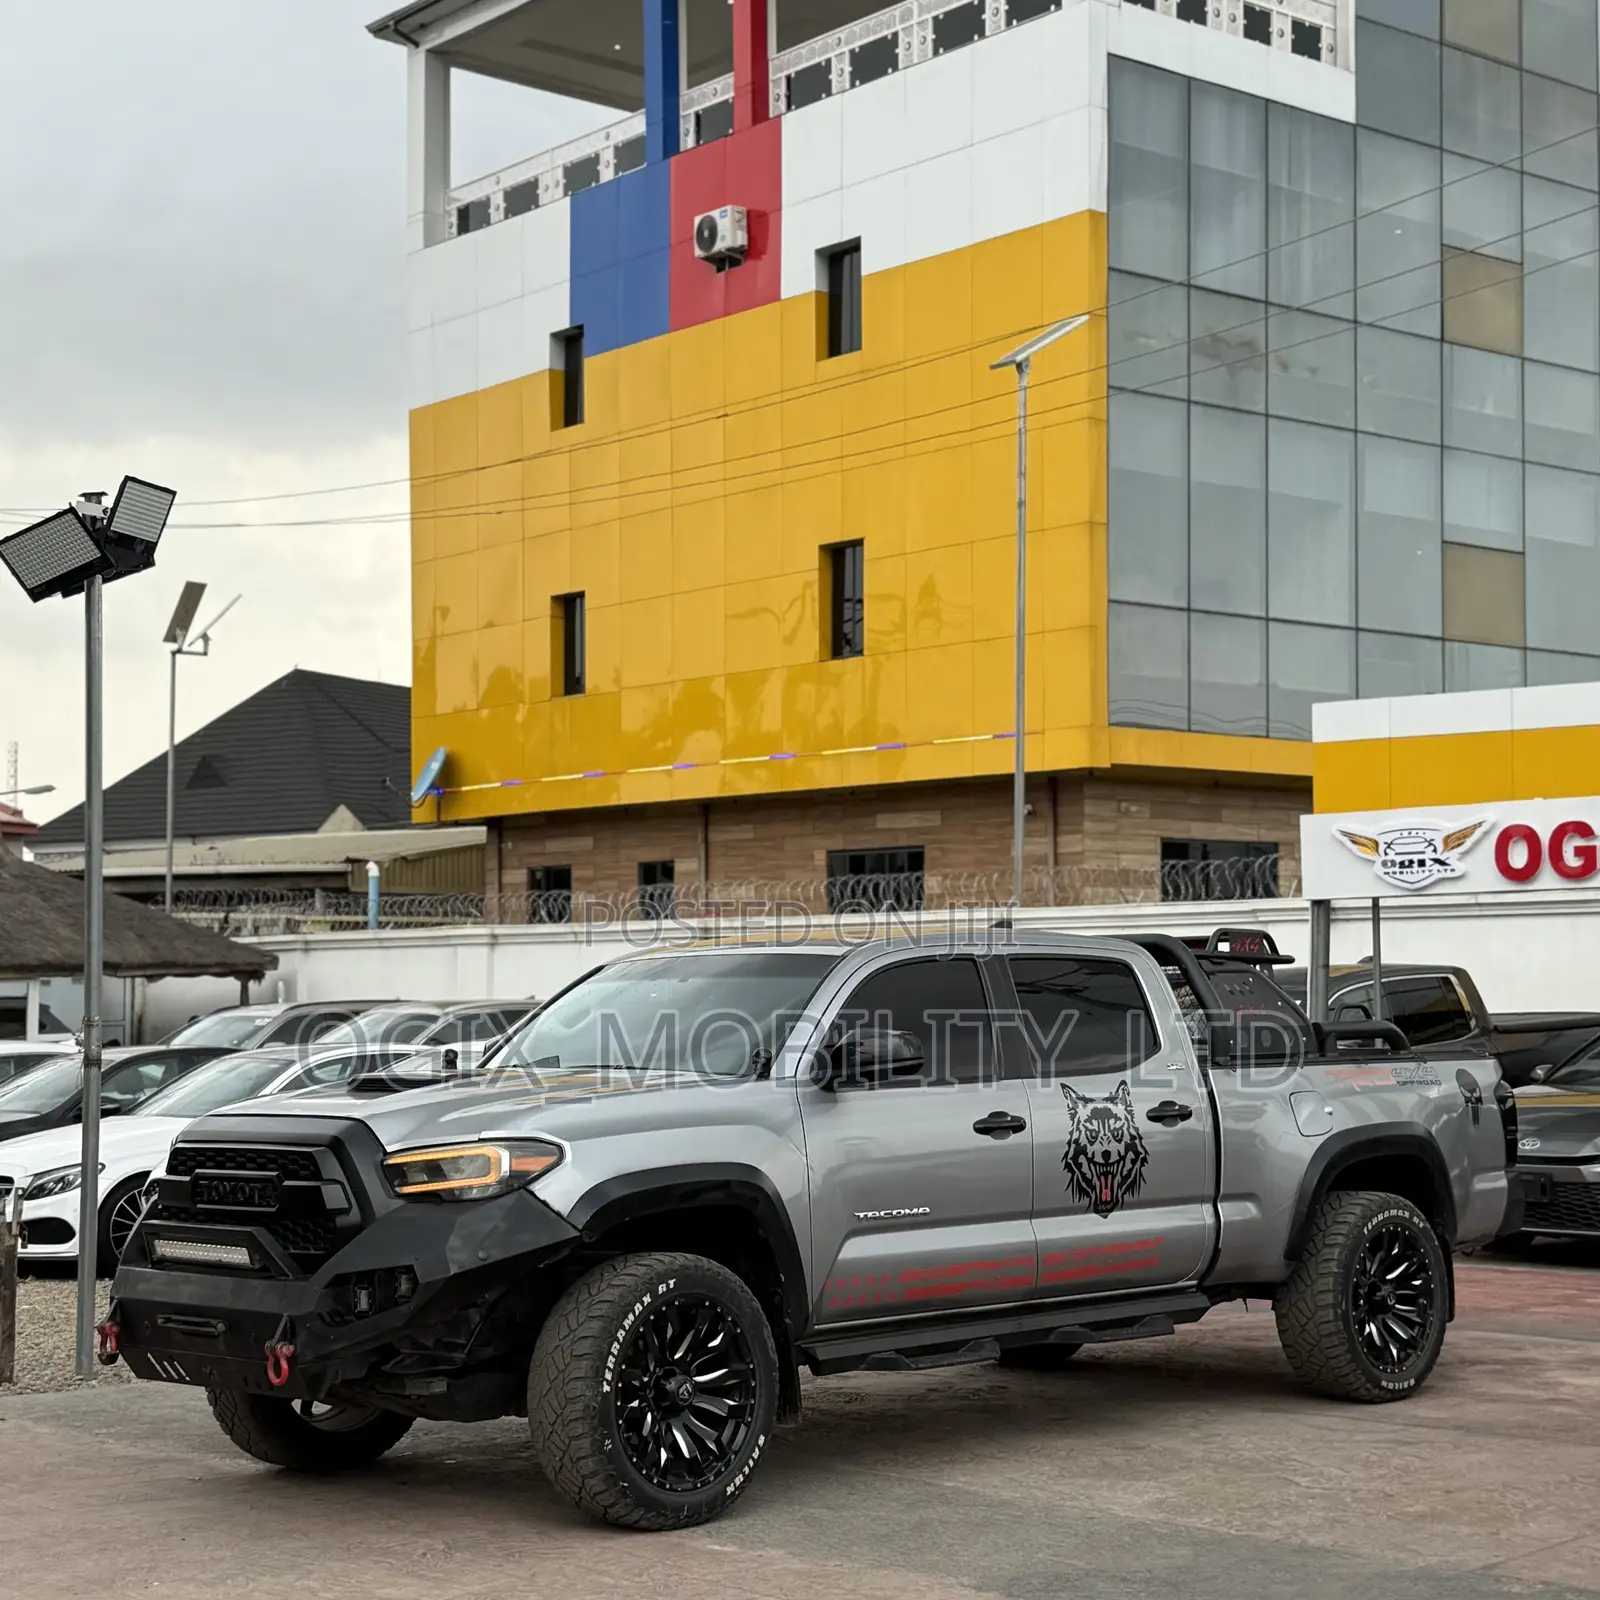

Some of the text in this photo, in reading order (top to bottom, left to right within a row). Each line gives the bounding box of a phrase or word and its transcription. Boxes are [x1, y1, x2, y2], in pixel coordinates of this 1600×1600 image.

[1495, 820, 1597, 882] OG
[1383, 868, 1434, 876] MOBILITY
[198, 1180, 278, 1206] TOYOTA
[853, 1207, 931, 1219] TACOMA
[1363, 1209, 1410, 1235] TERRAMAX
[602, 1278, 677, 1393] TERRAMAX AT
[726, 1433, 766, 1497] SAILUN
